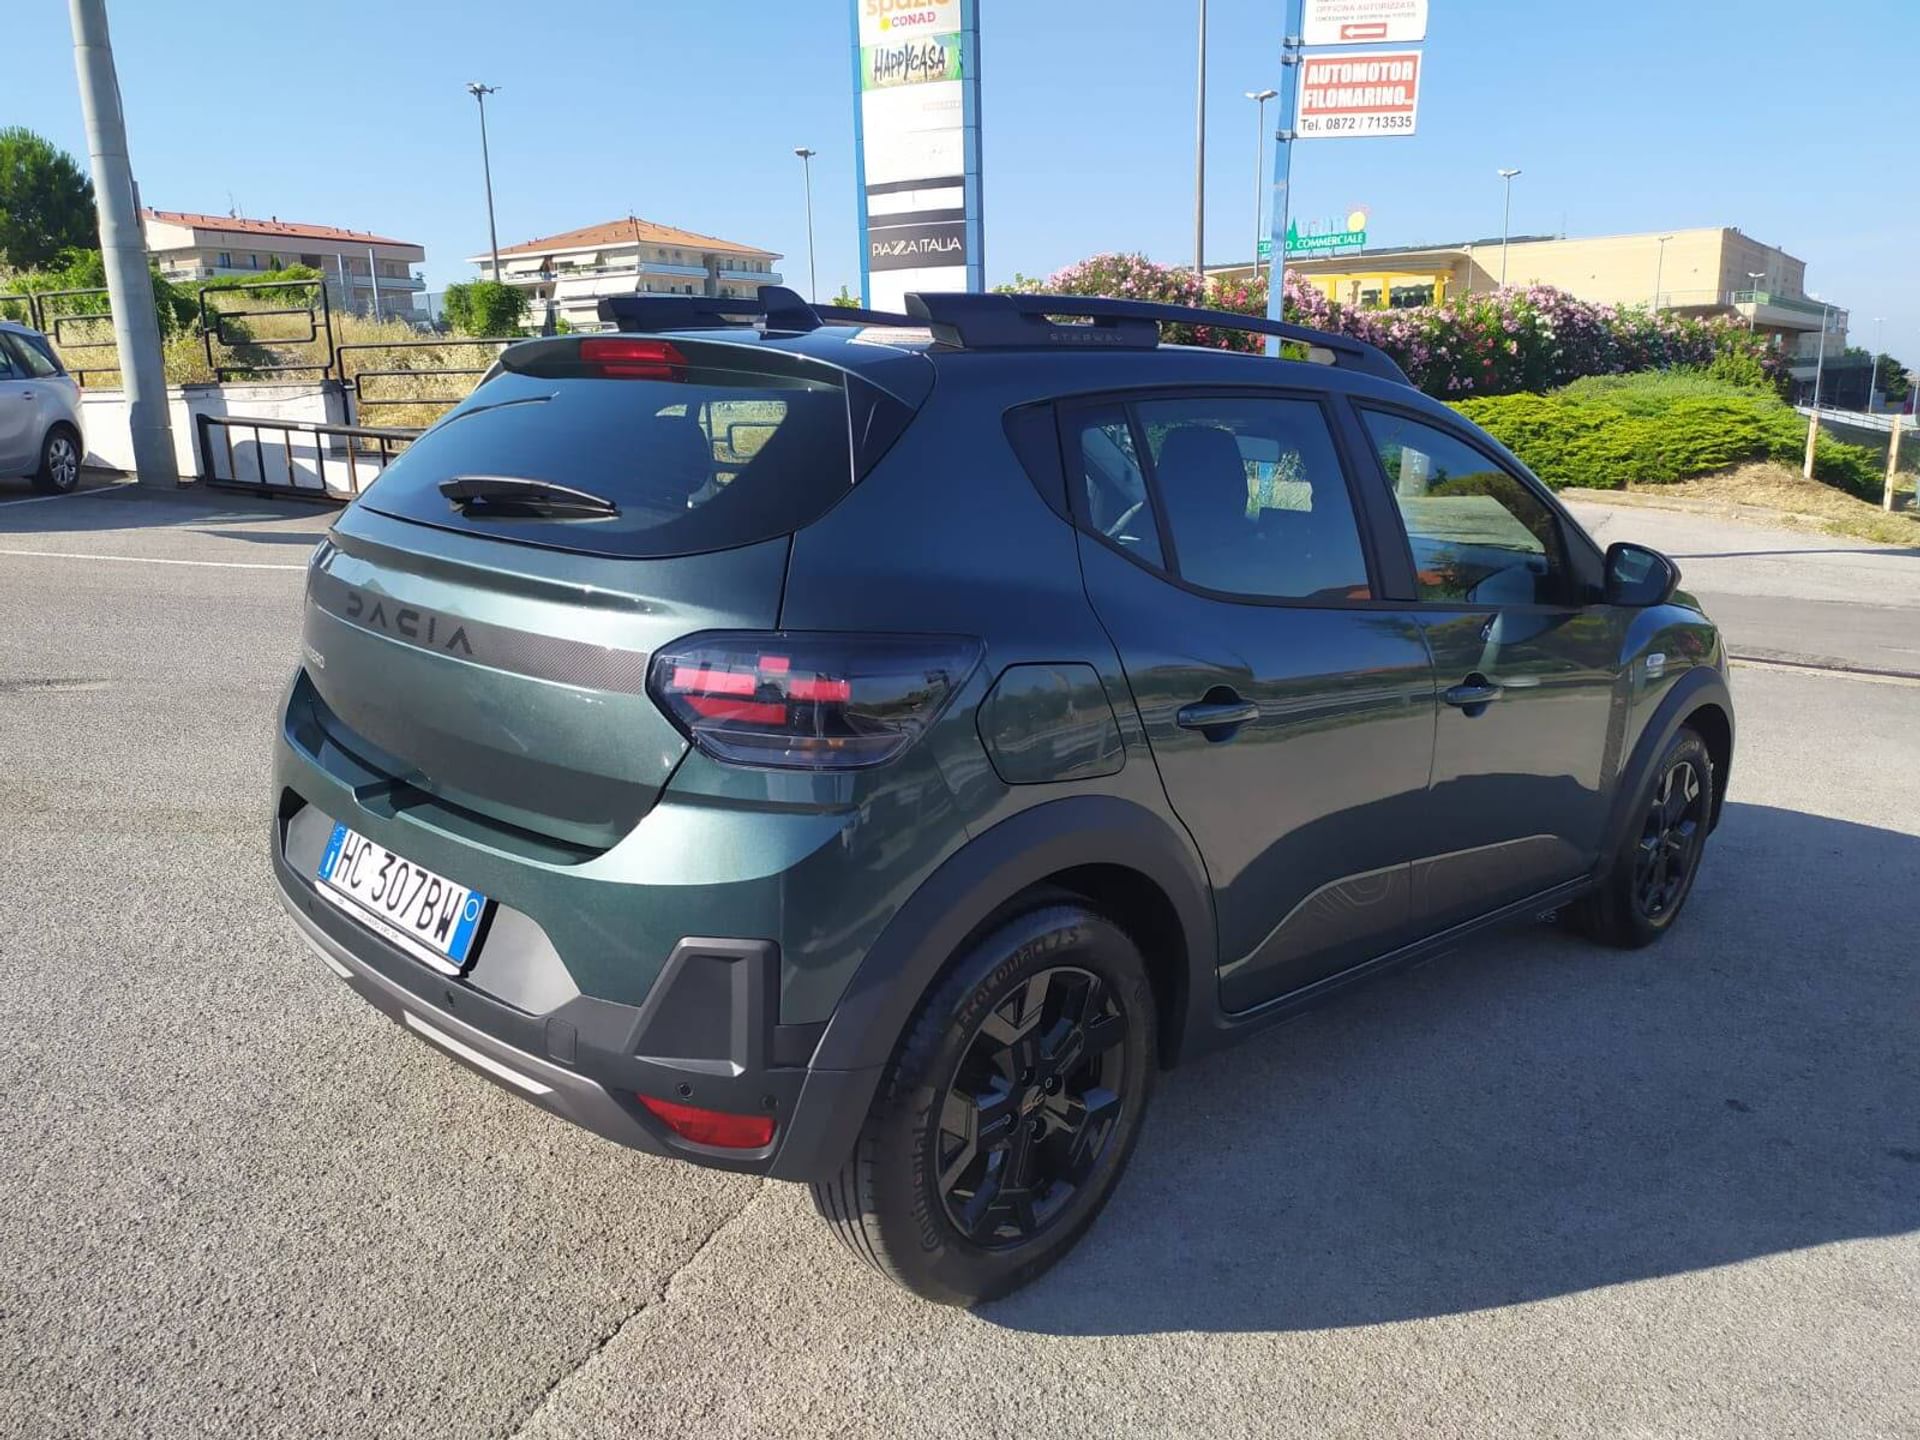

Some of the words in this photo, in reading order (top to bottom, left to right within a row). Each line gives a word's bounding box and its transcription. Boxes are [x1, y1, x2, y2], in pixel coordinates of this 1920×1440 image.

[891, 11, 937, 27] CONAD
[1306, 61, 1415, 85] AUTOMOTOR
[1303, 86, 1406, 109] FILOMARINO
[1301, 118, 1322, 131] Tel.
[1326, 117, 1356, 130] 0872
[1367, 116, 1412, 129] 713535
[919, 237, 962, 253] ITALIA
[1259, 240, 1293, 251] CEO
[1297, 232, 1364, 249] COMMERCIALE
[346, 591, 473, 655] DACIA
[335, 832, 372, 889] HC
[371, 852, 463, 944] 307BW
